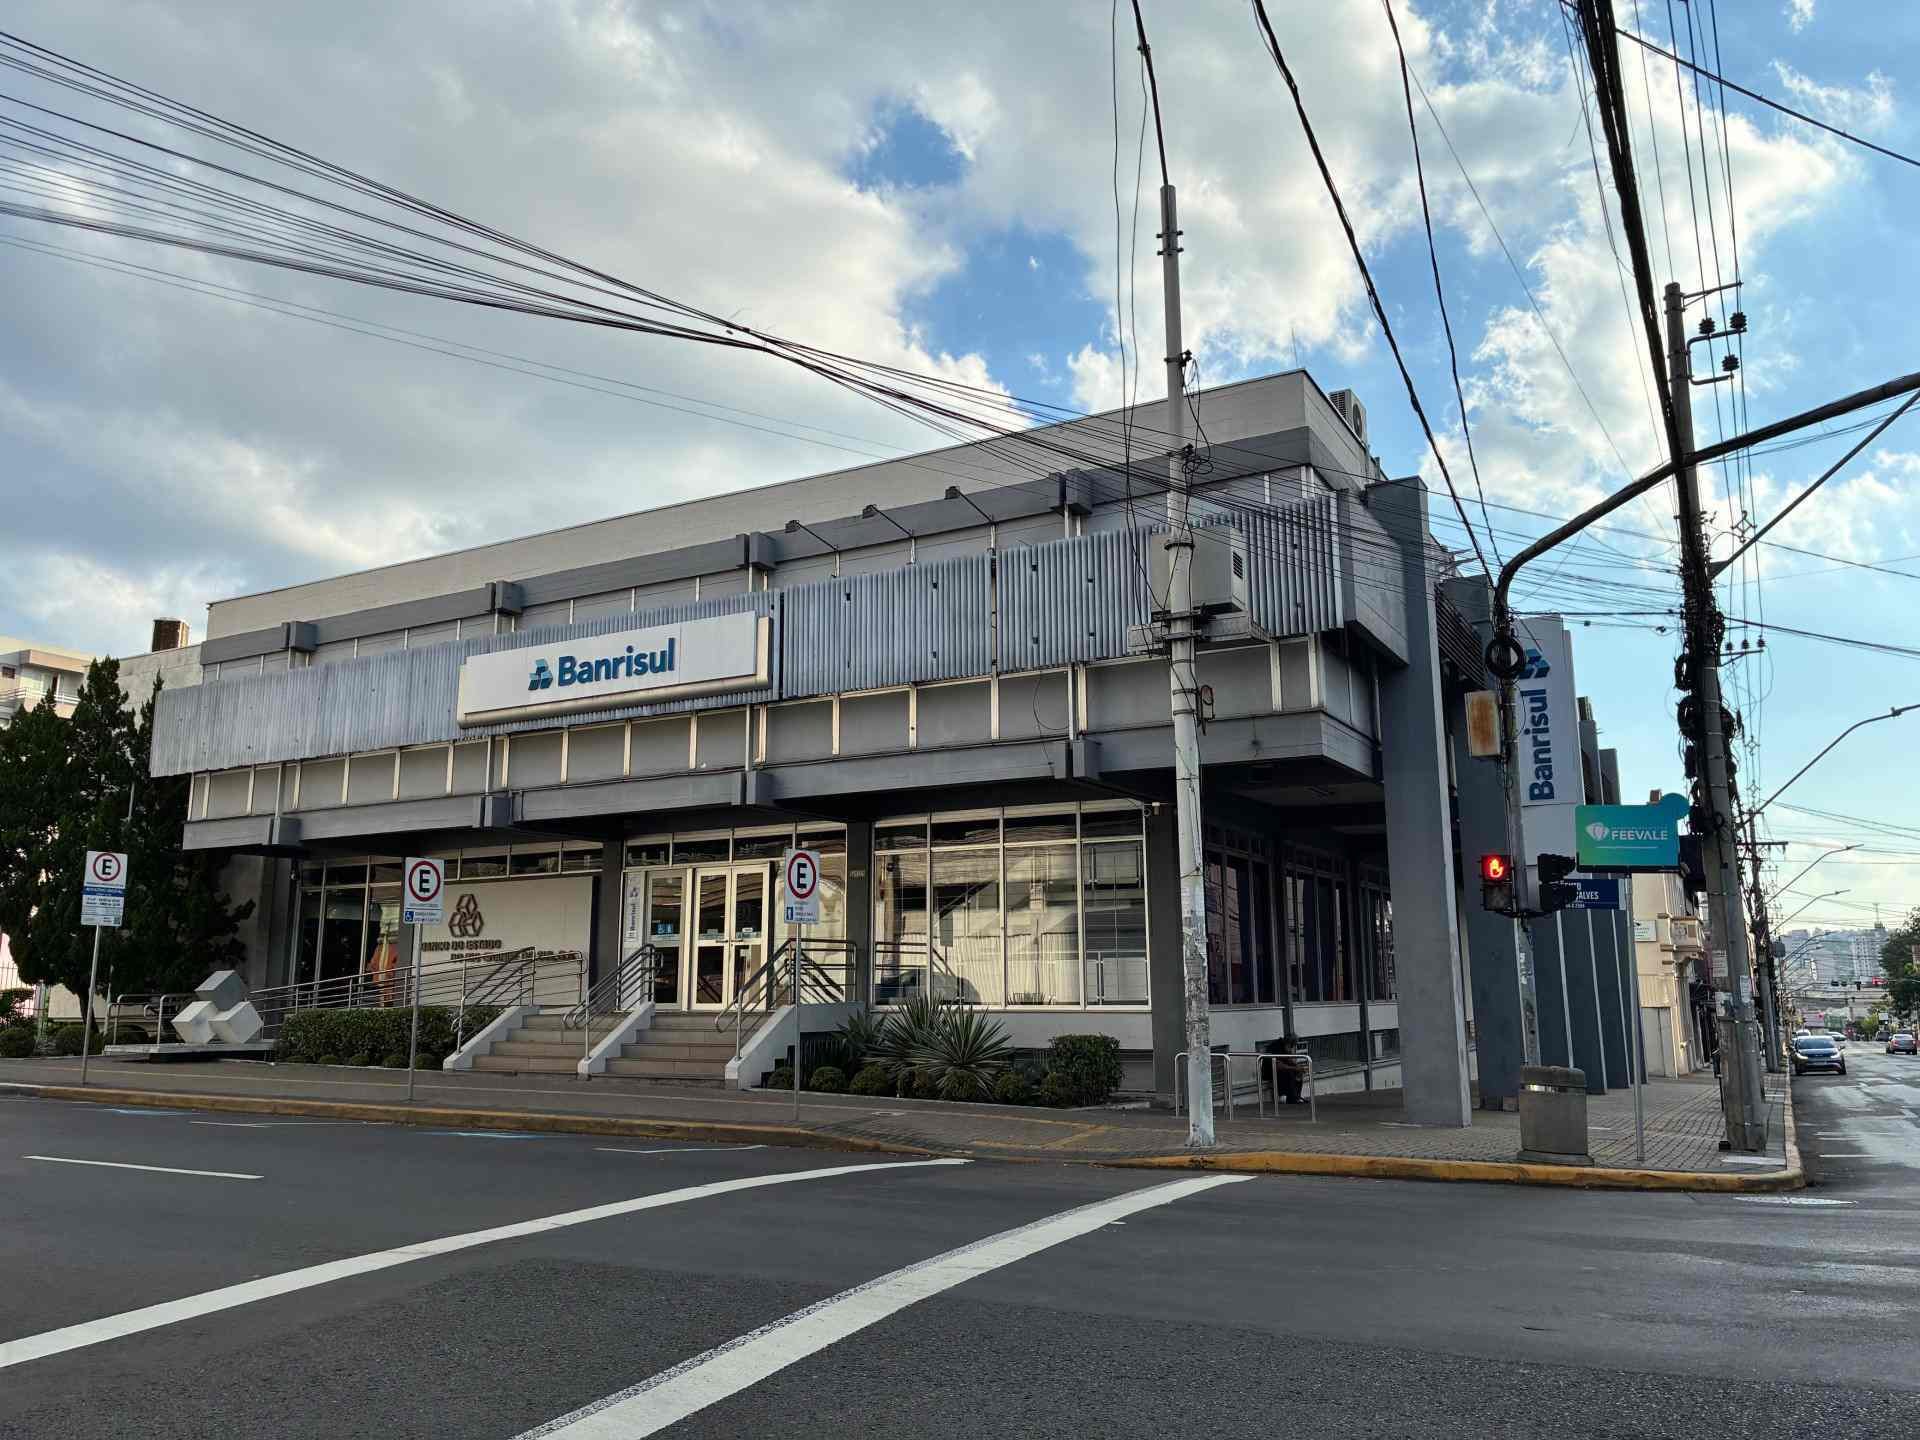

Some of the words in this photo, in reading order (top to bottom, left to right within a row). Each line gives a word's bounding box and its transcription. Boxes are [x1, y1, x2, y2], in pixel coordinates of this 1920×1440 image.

[558, 637, 675, 687] Banrisul
[1520, 688, 1555, 801] Banrisul
[1611, 830, 1668, 840] FEEVALE
[102, 858, 112, 875] E
[797, 862, 807, 889] E
[419, 869, 430, 893] E
